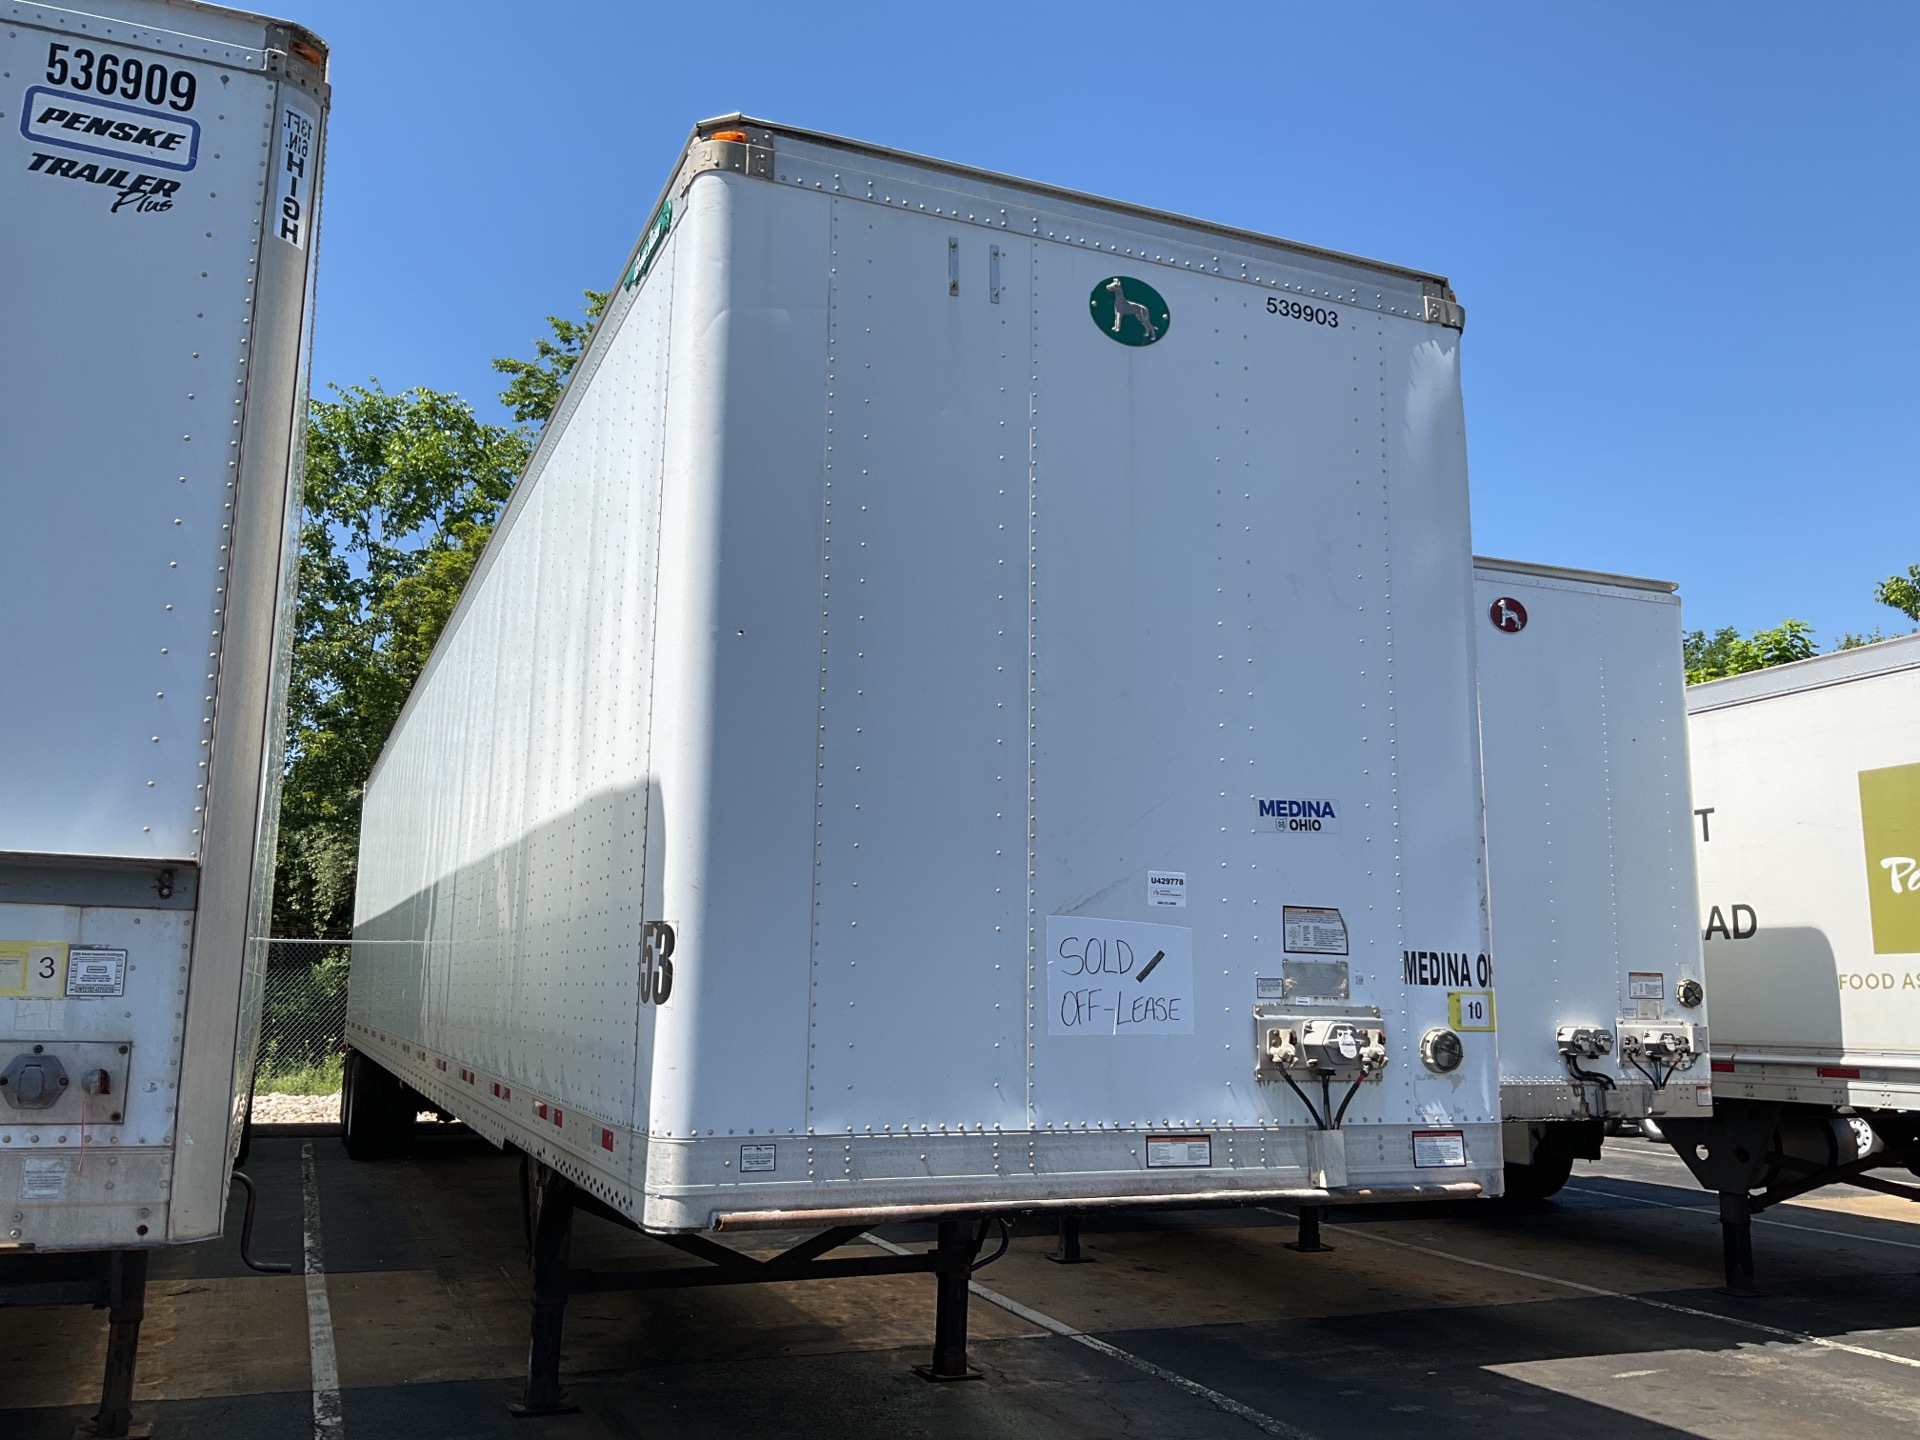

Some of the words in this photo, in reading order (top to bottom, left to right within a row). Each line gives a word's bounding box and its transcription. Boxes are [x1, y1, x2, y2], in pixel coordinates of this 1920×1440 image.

[46, 42, 197, 112] 536909
[36, 106, 186, 152] PENSKE
[27, 152, 181, 199] TRAILER
[111, 190, 173, 213] Plus
[1266, 297, 1339, 328] 539903
[1259, 800, 1336, 818] MEDINA
[1289, 819, 1322, 831] OHIO
[1151, 877, 1184, 886] U429778
[1702, 904, 1757, 940] AD
[39, 956, 55, 979] 3
[640, 923, 675, 1005] 53
[1403, 951, 1472, 987] MEDINA
[1839, 973, 1895, 990] FOOD
[1061, 988, 1181, 1027] OFF-LEASE
[1468, 1002, 1483, 1019] 10
